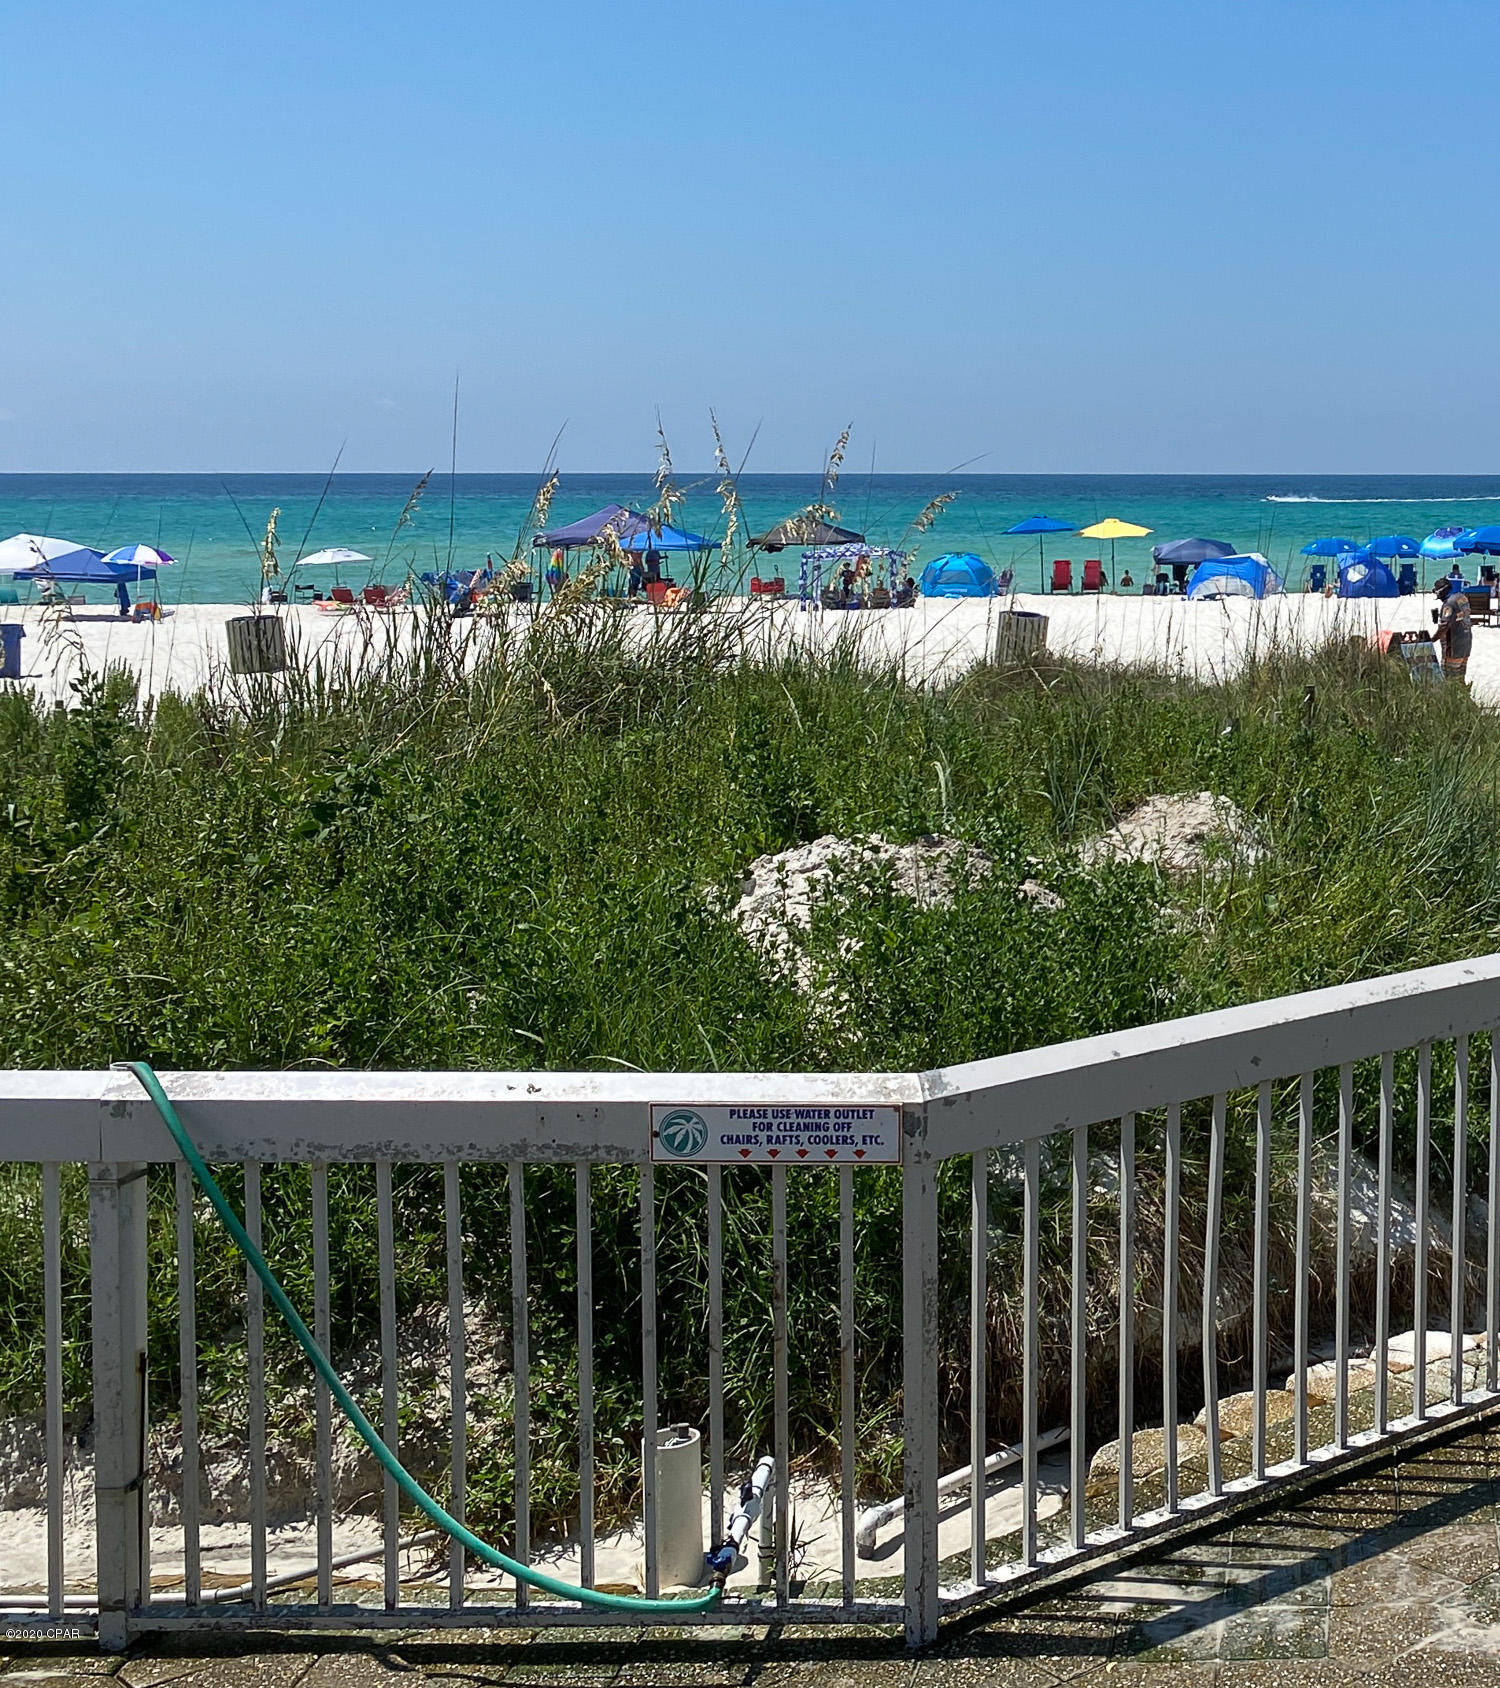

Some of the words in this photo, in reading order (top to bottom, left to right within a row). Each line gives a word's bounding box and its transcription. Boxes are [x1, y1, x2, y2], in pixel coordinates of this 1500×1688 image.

[729, 1108, 769, 1120] PLEASE
[771, 1109, 792, 1120] USE
[793, 1109, 831, 1120] WATER
[833, 1109, 875, 1120] OUTLET
[752, 1121, 774, 1132] FOR
[776, 1121, 830, 1132] CLEANING
[833, 1121, 853, 1132] OFF
[720, 1134, 763, 1147] CHAIRS,
[766, 1134, 805, 1147] RAFTS,
[807, 1134, 859, 1147] COOLERS,
[862, 1134, 885, 1146] ETC.
